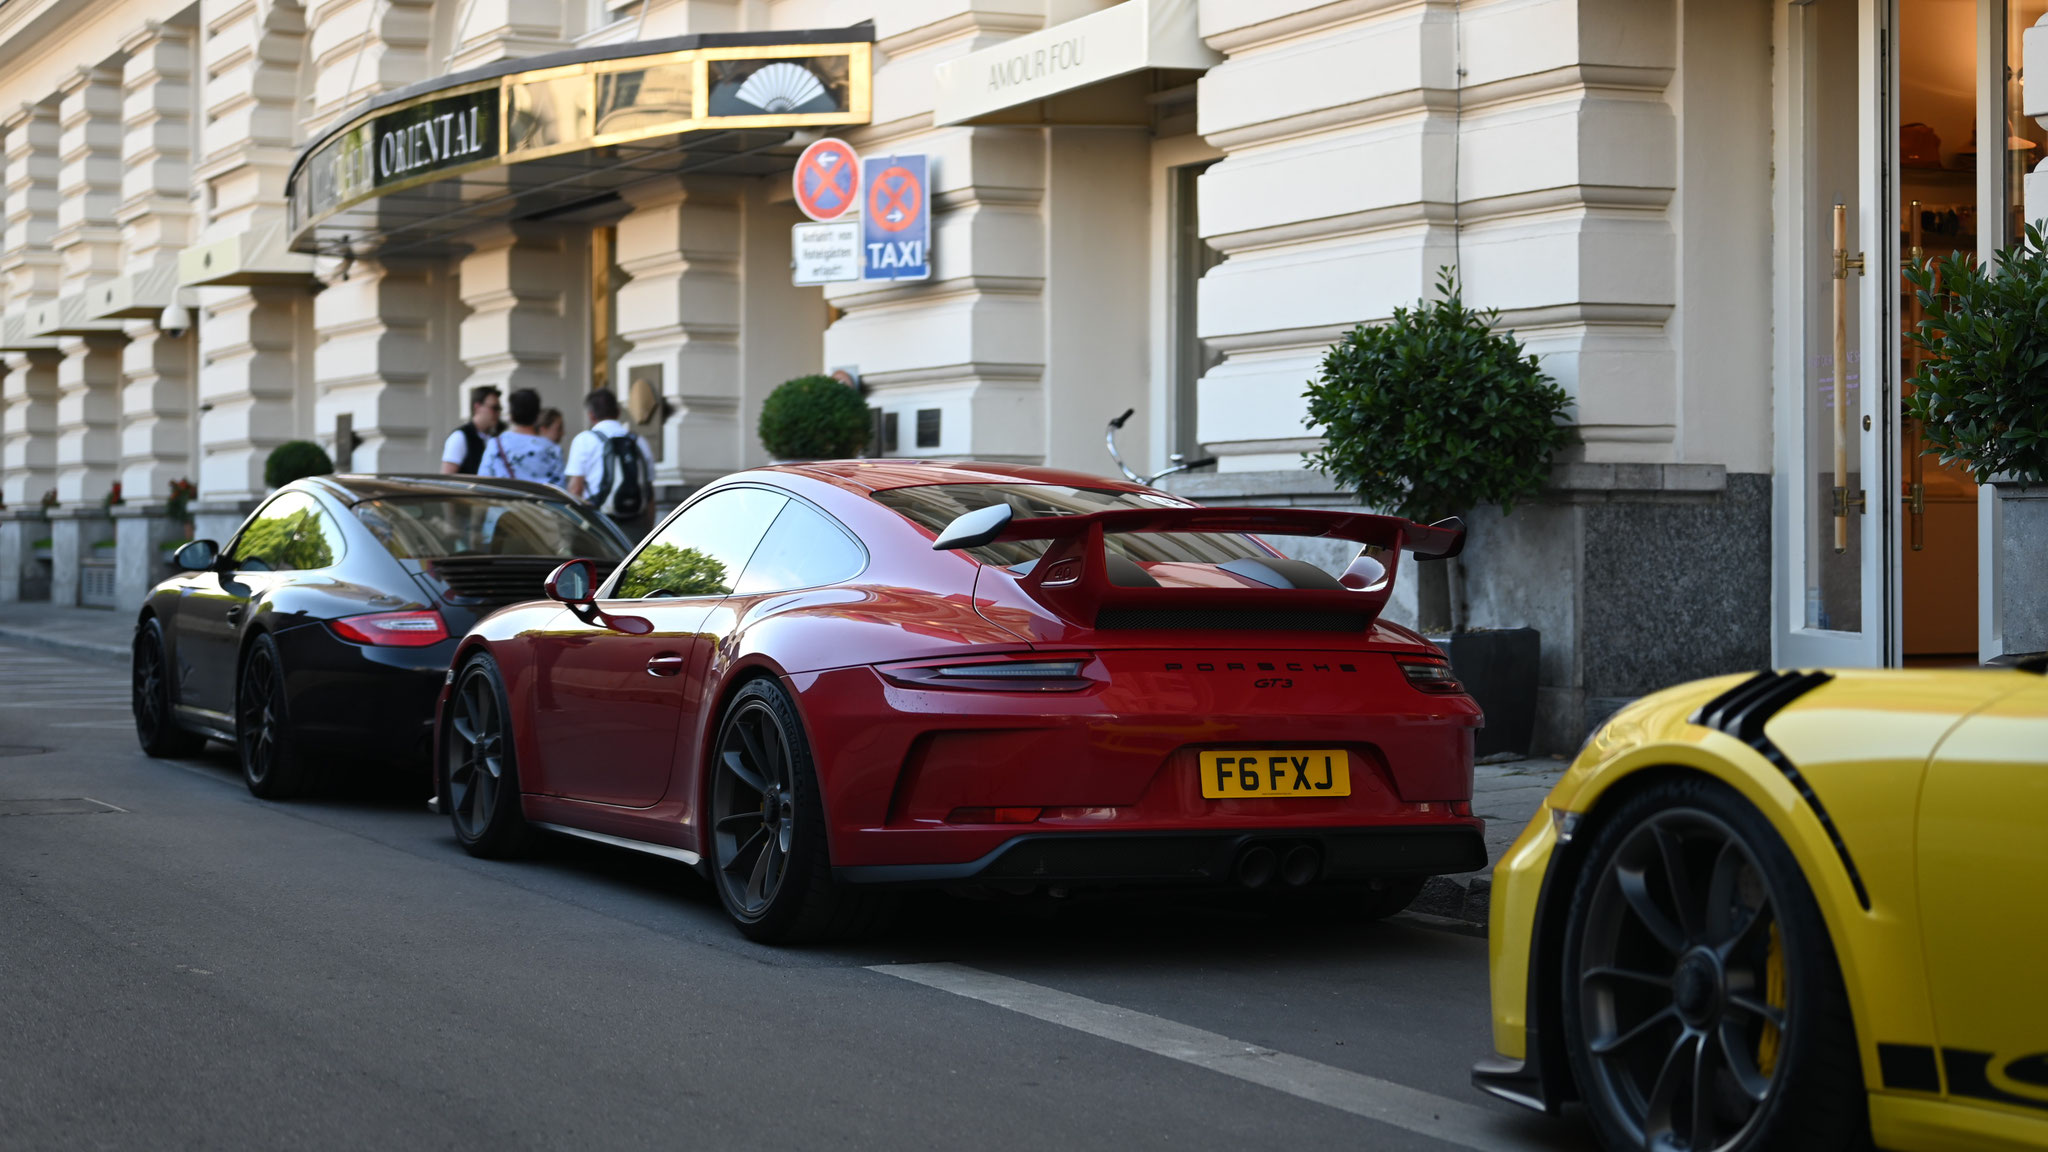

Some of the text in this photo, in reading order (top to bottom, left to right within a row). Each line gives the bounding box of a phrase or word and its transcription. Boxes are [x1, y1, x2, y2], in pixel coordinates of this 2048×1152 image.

[987, 35, 1086, 93] AMOUR FOU
[380, 106, 482, 178] ORIENTAL
[867, 240, 923, 270] TAXI
[1164, 662, 1358, 673] PORSCHE
[1253, 678, 1294, 688] GT3
[1215, 756, 1333, 792] F6 FXJ
